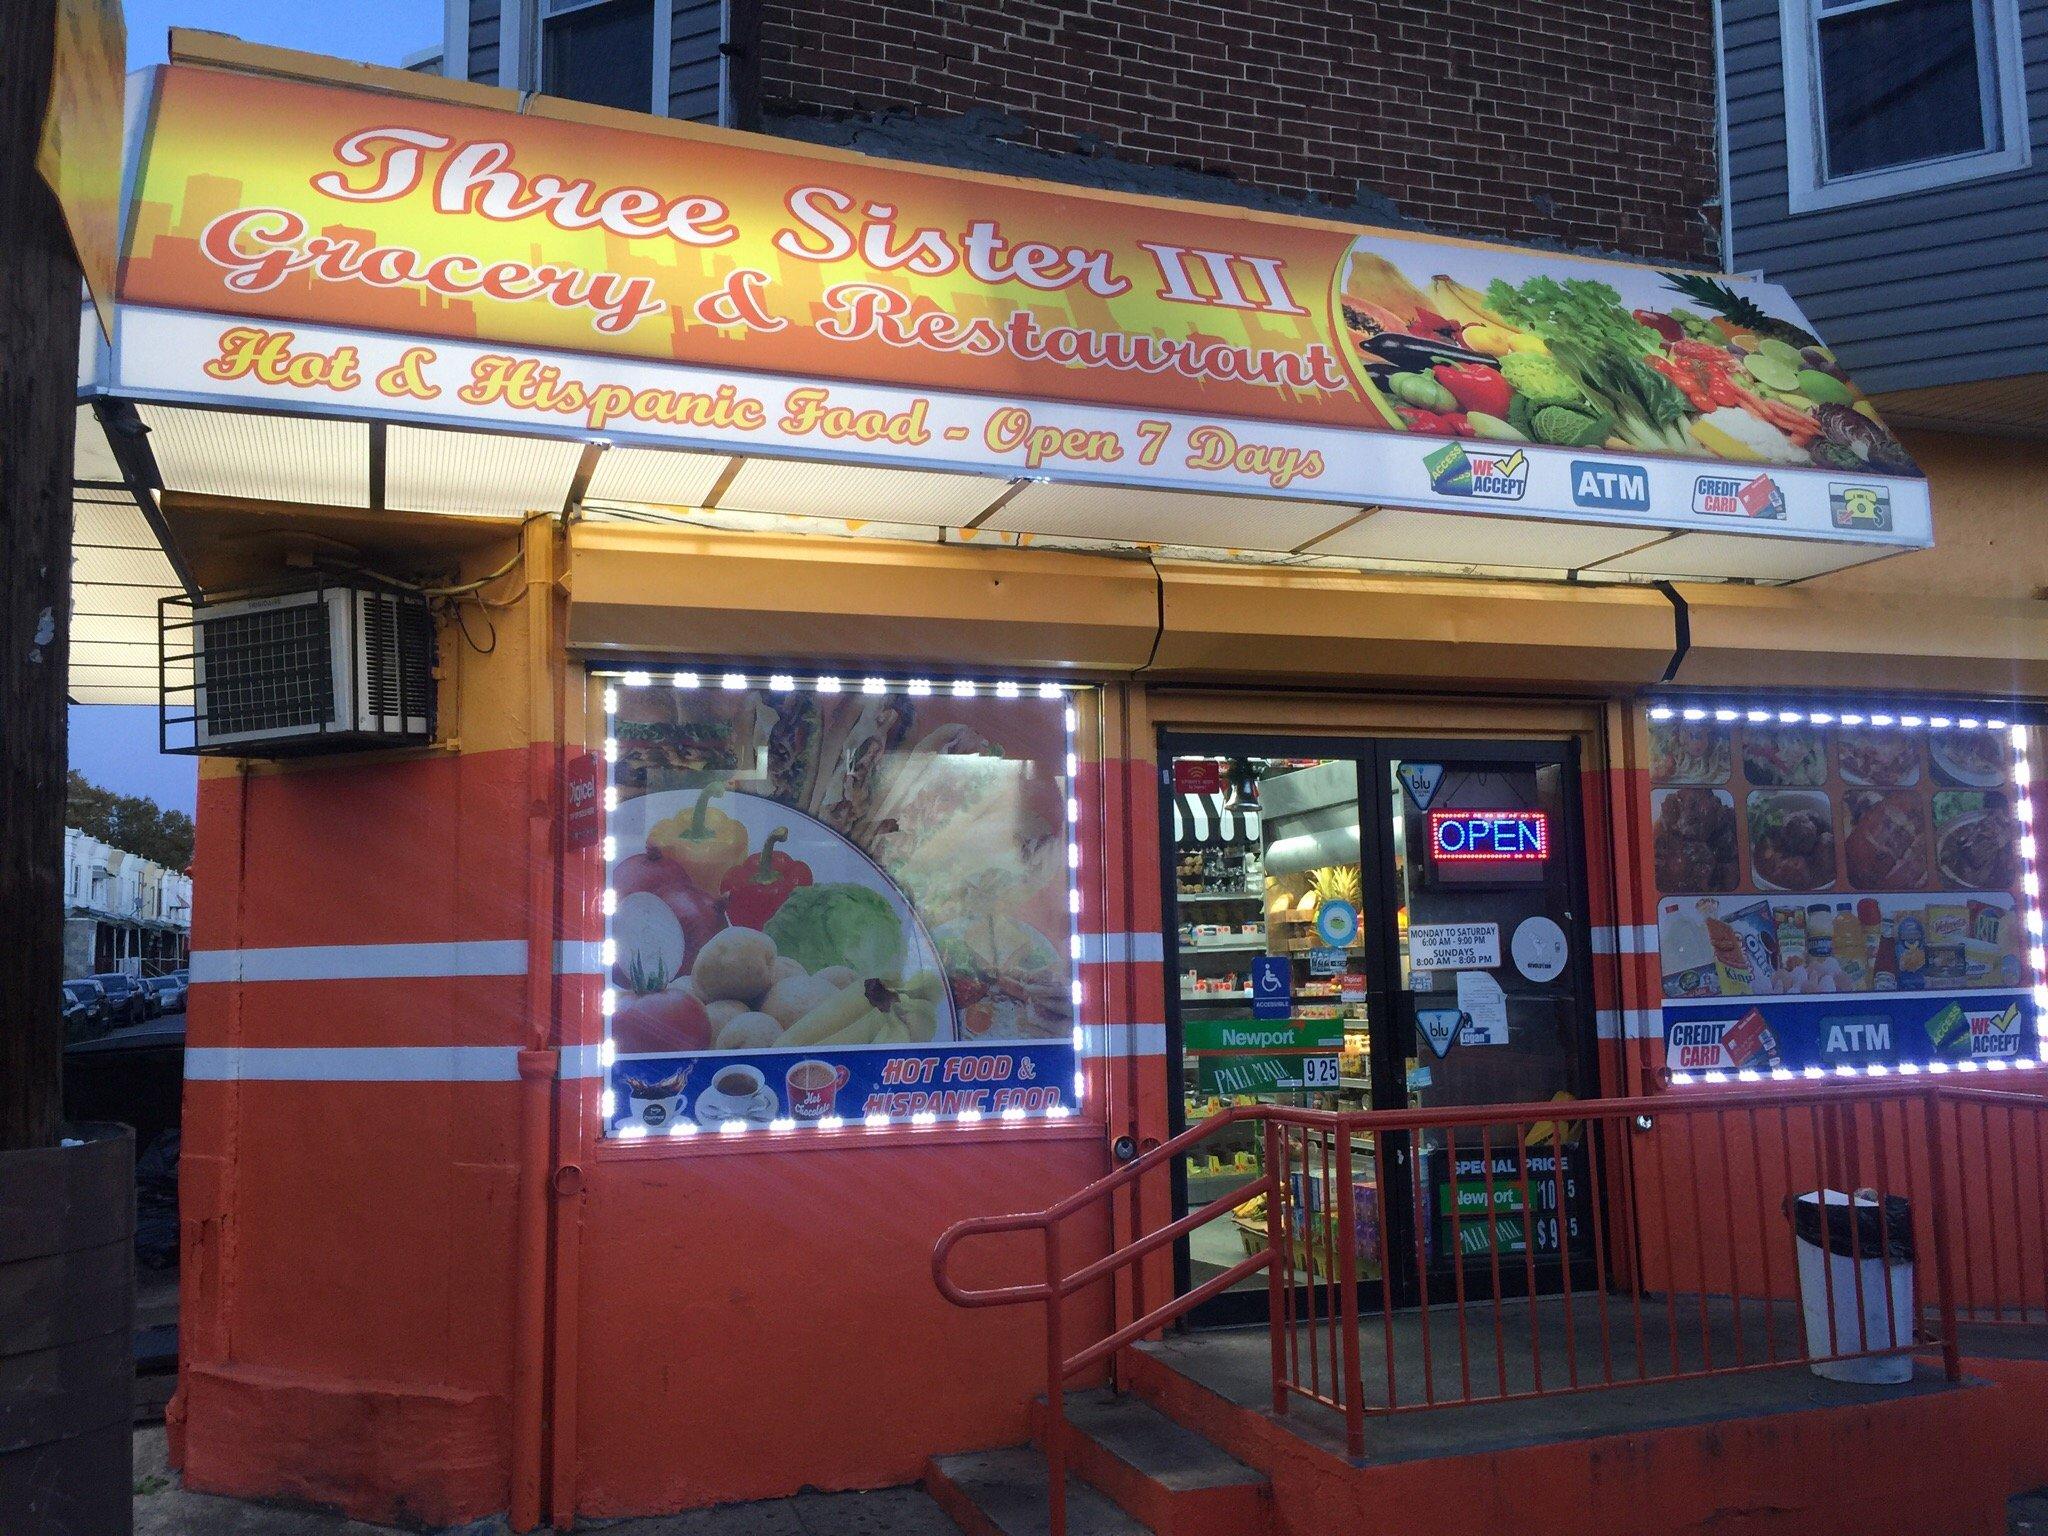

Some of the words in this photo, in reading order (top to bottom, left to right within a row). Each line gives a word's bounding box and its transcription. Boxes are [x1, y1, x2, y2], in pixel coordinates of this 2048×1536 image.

[310, 125, 738, 246] Three
[773, 184, 1128, 297] Sister
[1137, 241, 1311, 317] III
[199, 206, 665, 335] Grocery
[694, 268, 787, 332] &
[815, 281, 1349, 392] Restaurant
[203, 326, 361, 390] Hot
[376, 347, 441, 399] &
[458, 356, 766, 430] Hispanic
[779, 387, 929, 447] Food
[944, 424, 970, 441] -
[983, 406, 1123, 470] Open
[1136, 419, 1171, 466] 7
[1185, 425, 1325, 489] Days
[1431, 445, 1462, 479] ACCESS
[1473, 459, 1494, 477] WE
[1473, 476, 1524, 496] ACCEPT
[1577, 469, 1646, 501] ATM
[1698, 479, 1741, 498] CREDIT
[1704, 495, 1737, 513] CARD
[1411, 775, 1431, 790] blu
[1438, 820, 1542, 851] OPEN
[1411, 929, 1445, 939] MONDAY
[1446, 928, 1456, 937] TO
[1457, 926, 1496, 937] SATURDAY
[1422, 937, 1437, 947] 6:00
[1438, 937, 1451, 946] AM
[1457, 936, 1473, 945] 9:00
[1473, 936, 1486, 944] PM
[1416, 957, 1434, 967] 8:00
[1435, 956, 1451, 965] AM
[1458, 956, 1476, 965] 8:00
[1478, 955, 1493, 964] PM
[1433, 948, 1475, 958] SUNDAYS
[1430, 1021, 1449, 1038] blu
[1673, 1024, 1726, 1046] CREDIT
[1970, 1017, 1990, 1035] WE
[1222, 1029, 1296, 1048] Newport
[1826, 1023, 1891, 1053] ATM
[1972, 1033, 2021, 1053] ACCEPT
[1679, 1045, 1720, 1067] CARD
[881, 1057, 940, 1085] HOT
[943, 1055, 1013, 1083] FOOD
[1017, 1056, 1037, 1081] &
[1214, 1065, 1255, 1094] PALL
[1252, 1059, 1290, 1083] MALL
[1307, 1059, 1338, 1082] 9.25
[862, 1088, 990, 1119] HISPANIC
[992, 1086, 1061, 1113] FOOD
